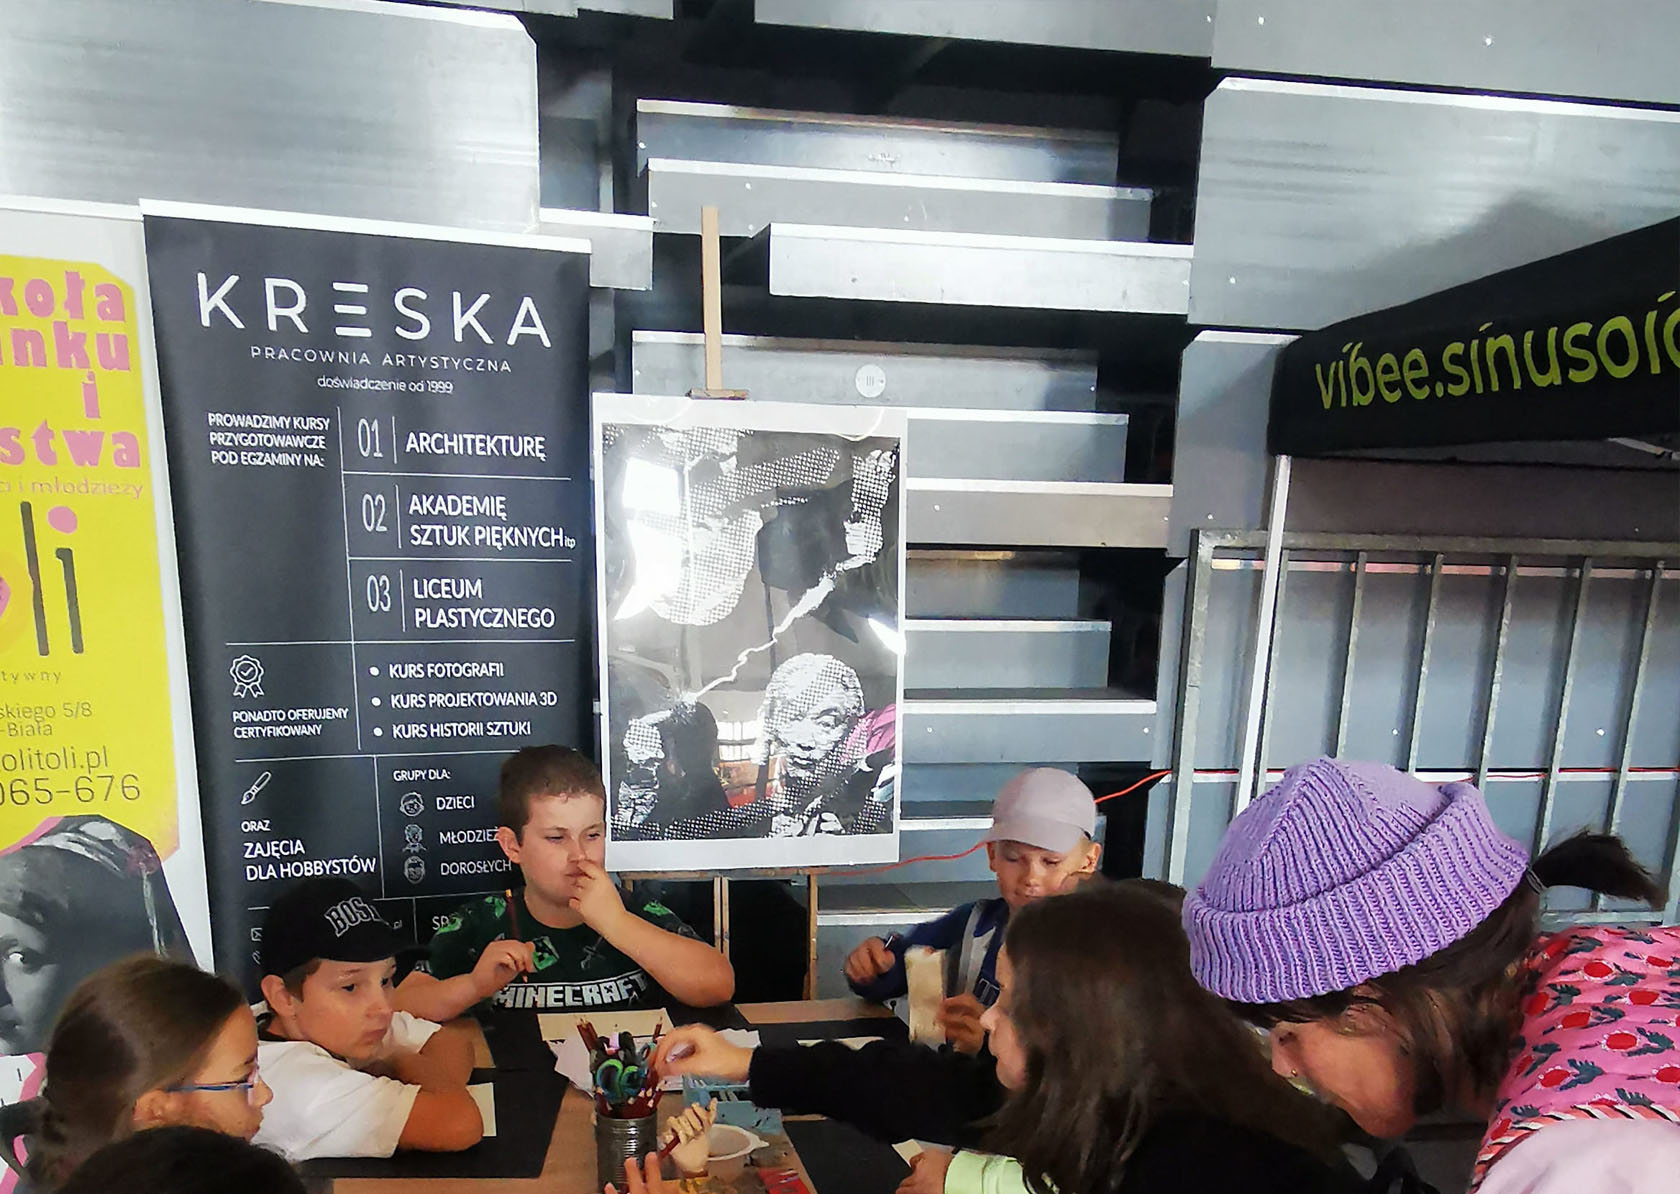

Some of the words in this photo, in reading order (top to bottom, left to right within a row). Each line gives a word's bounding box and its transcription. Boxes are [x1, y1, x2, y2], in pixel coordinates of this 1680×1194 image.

[197, 271, 552, 348] KRESKA
[0, 320, 130, 371] nku
[250, 345, 372, 366] PRACOWNIA
[382, 352, 512, 374] ARTYSTYCZNA
[82, 371, 101, 419] i
[317, 375, 406, 392] doświadczenie
[408, 380, 425, 392] od
[426, 380, 454, 395] 1999
[207, 412, 291, 430] PROWADZIMY
[293, 417, 330, 431] KURSY
[0, 419, 141, 468] stwa
[209, 432, 326, 450] PRZYGOTOWAWCZE
[357, 418, 384, 458] 01
[405, 432, 547, 462] ARCHITEKTURĘ
[211, 450, 239, 466] POD
[240, 452, 301, 467] EGZAMINY
[303, 454, 326, 468] NA:
[362, 494, 388, 532] 02
[408, 494, 507, 521] AKADEMIĘ
[410, 524, 471, 546] SZTUK
[474, 526, 563, 551] PIĘKNYCH
[366, 575, 391, 612] 03
[412, 578, 482, 600] LICEUM
[414, 608, 555, 629] PLASTYCZNEGO
[389, 663, 424, 679] KURS
[427, 662, 504, 678] FOTOGRAFII
[391, 693, 426, 709] KURS
[428, 692, 538, 708] PROJEKTOWANIA
[539, 691, 557, 706] 3D
[62, 702, 93, 719] 5/8
[233, 710, 286, 722] PONADTO
[287, 707, 349, 721] OFERUJEMY
[234, 725, 322, 739] CERTYFIKOWANY
[393, 723, 428, 739] KURS
[430, 722, 484, 738] HISTORII
[486, 721, 531, 736] SZTUKI
[1, 745, 109, 774] olitoli.pl
[393, 770, 427, 781] GRUPY
[428, 769, 451, 780] DLA:
[0, 774, 141, 806] 65-676
[436, 795, 475, 810] DZIECI
[241, 820, 271, 832] ORAZ
[243, 839, 305, 859] ZAJĘCIA
[246, 863, 278, 881] DLA
[280, 855, 377, 879] HOBBYSTÓW
[440, 859, 512, 876] DOROSŁYCH
[324, 897, 381, 938] BOS
[495, 973, 648, 1009] MINECRAFT
